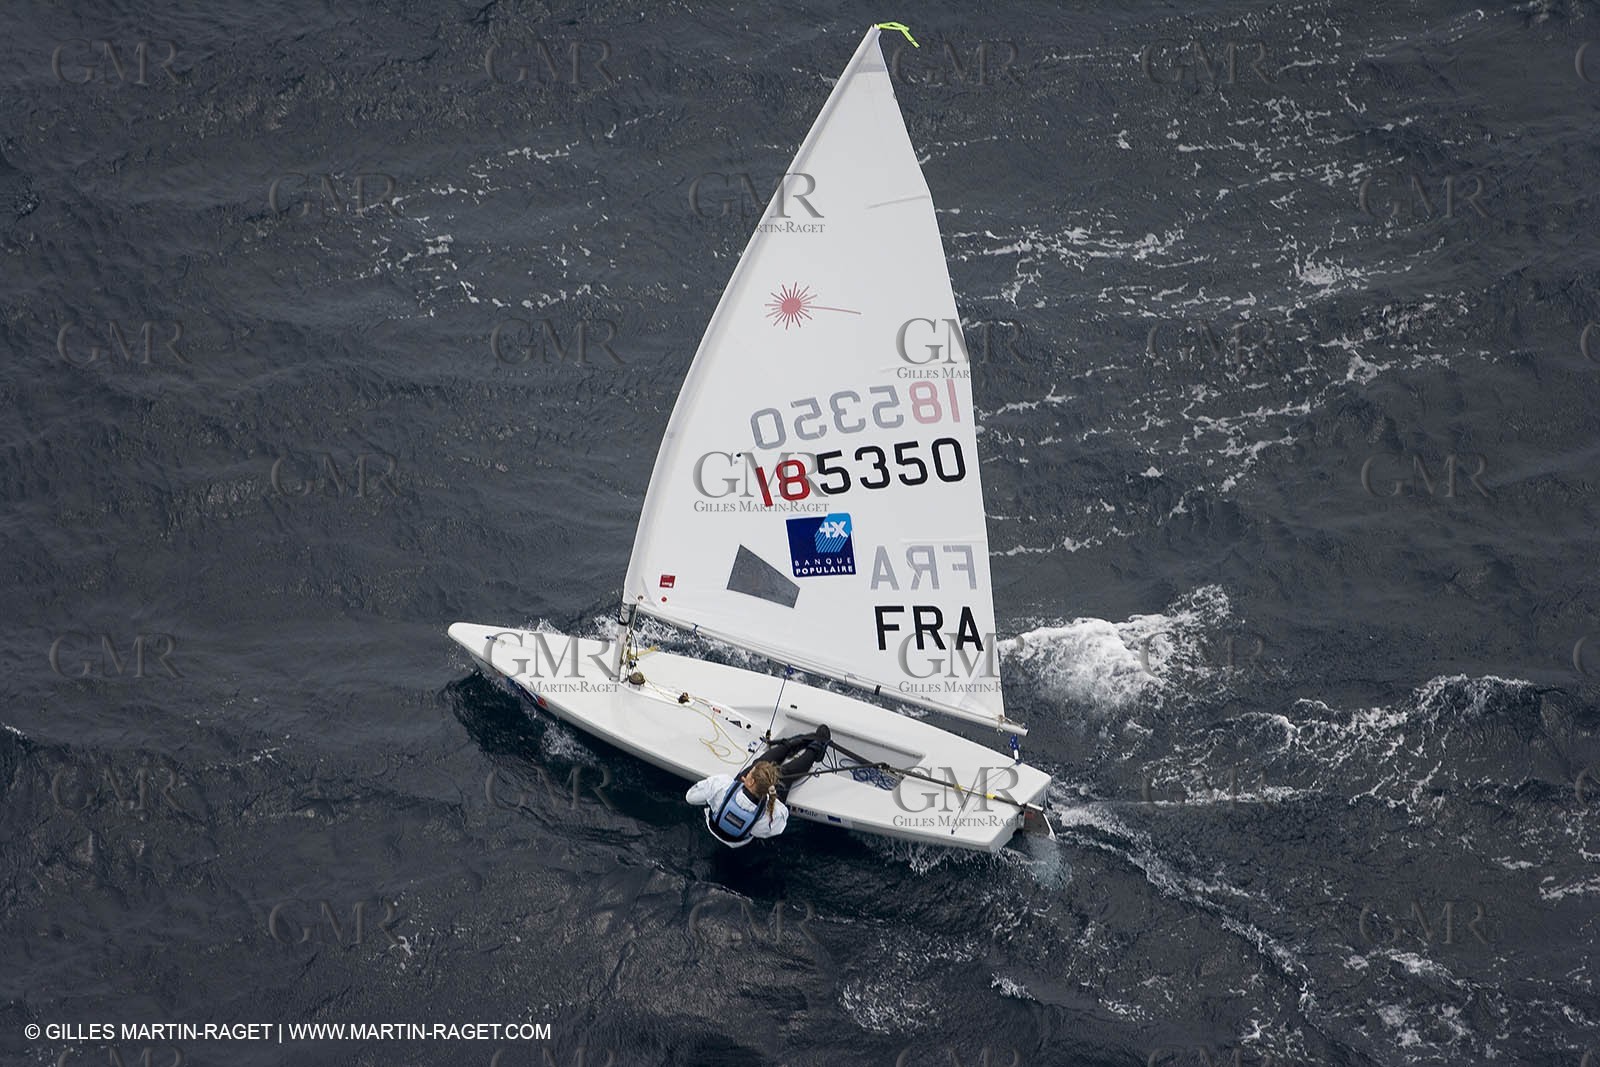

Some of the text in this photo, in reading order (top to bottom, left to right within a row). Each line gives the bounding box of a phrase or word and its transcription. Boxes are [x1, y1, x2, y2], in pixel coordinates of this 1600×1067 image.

[755, 437, 966, 507] 185350
[794, 556, 851, 567] BANQUE
[795, 565, 853, 576] POPULAIRE
[874, 605, 984, 651] FRA
